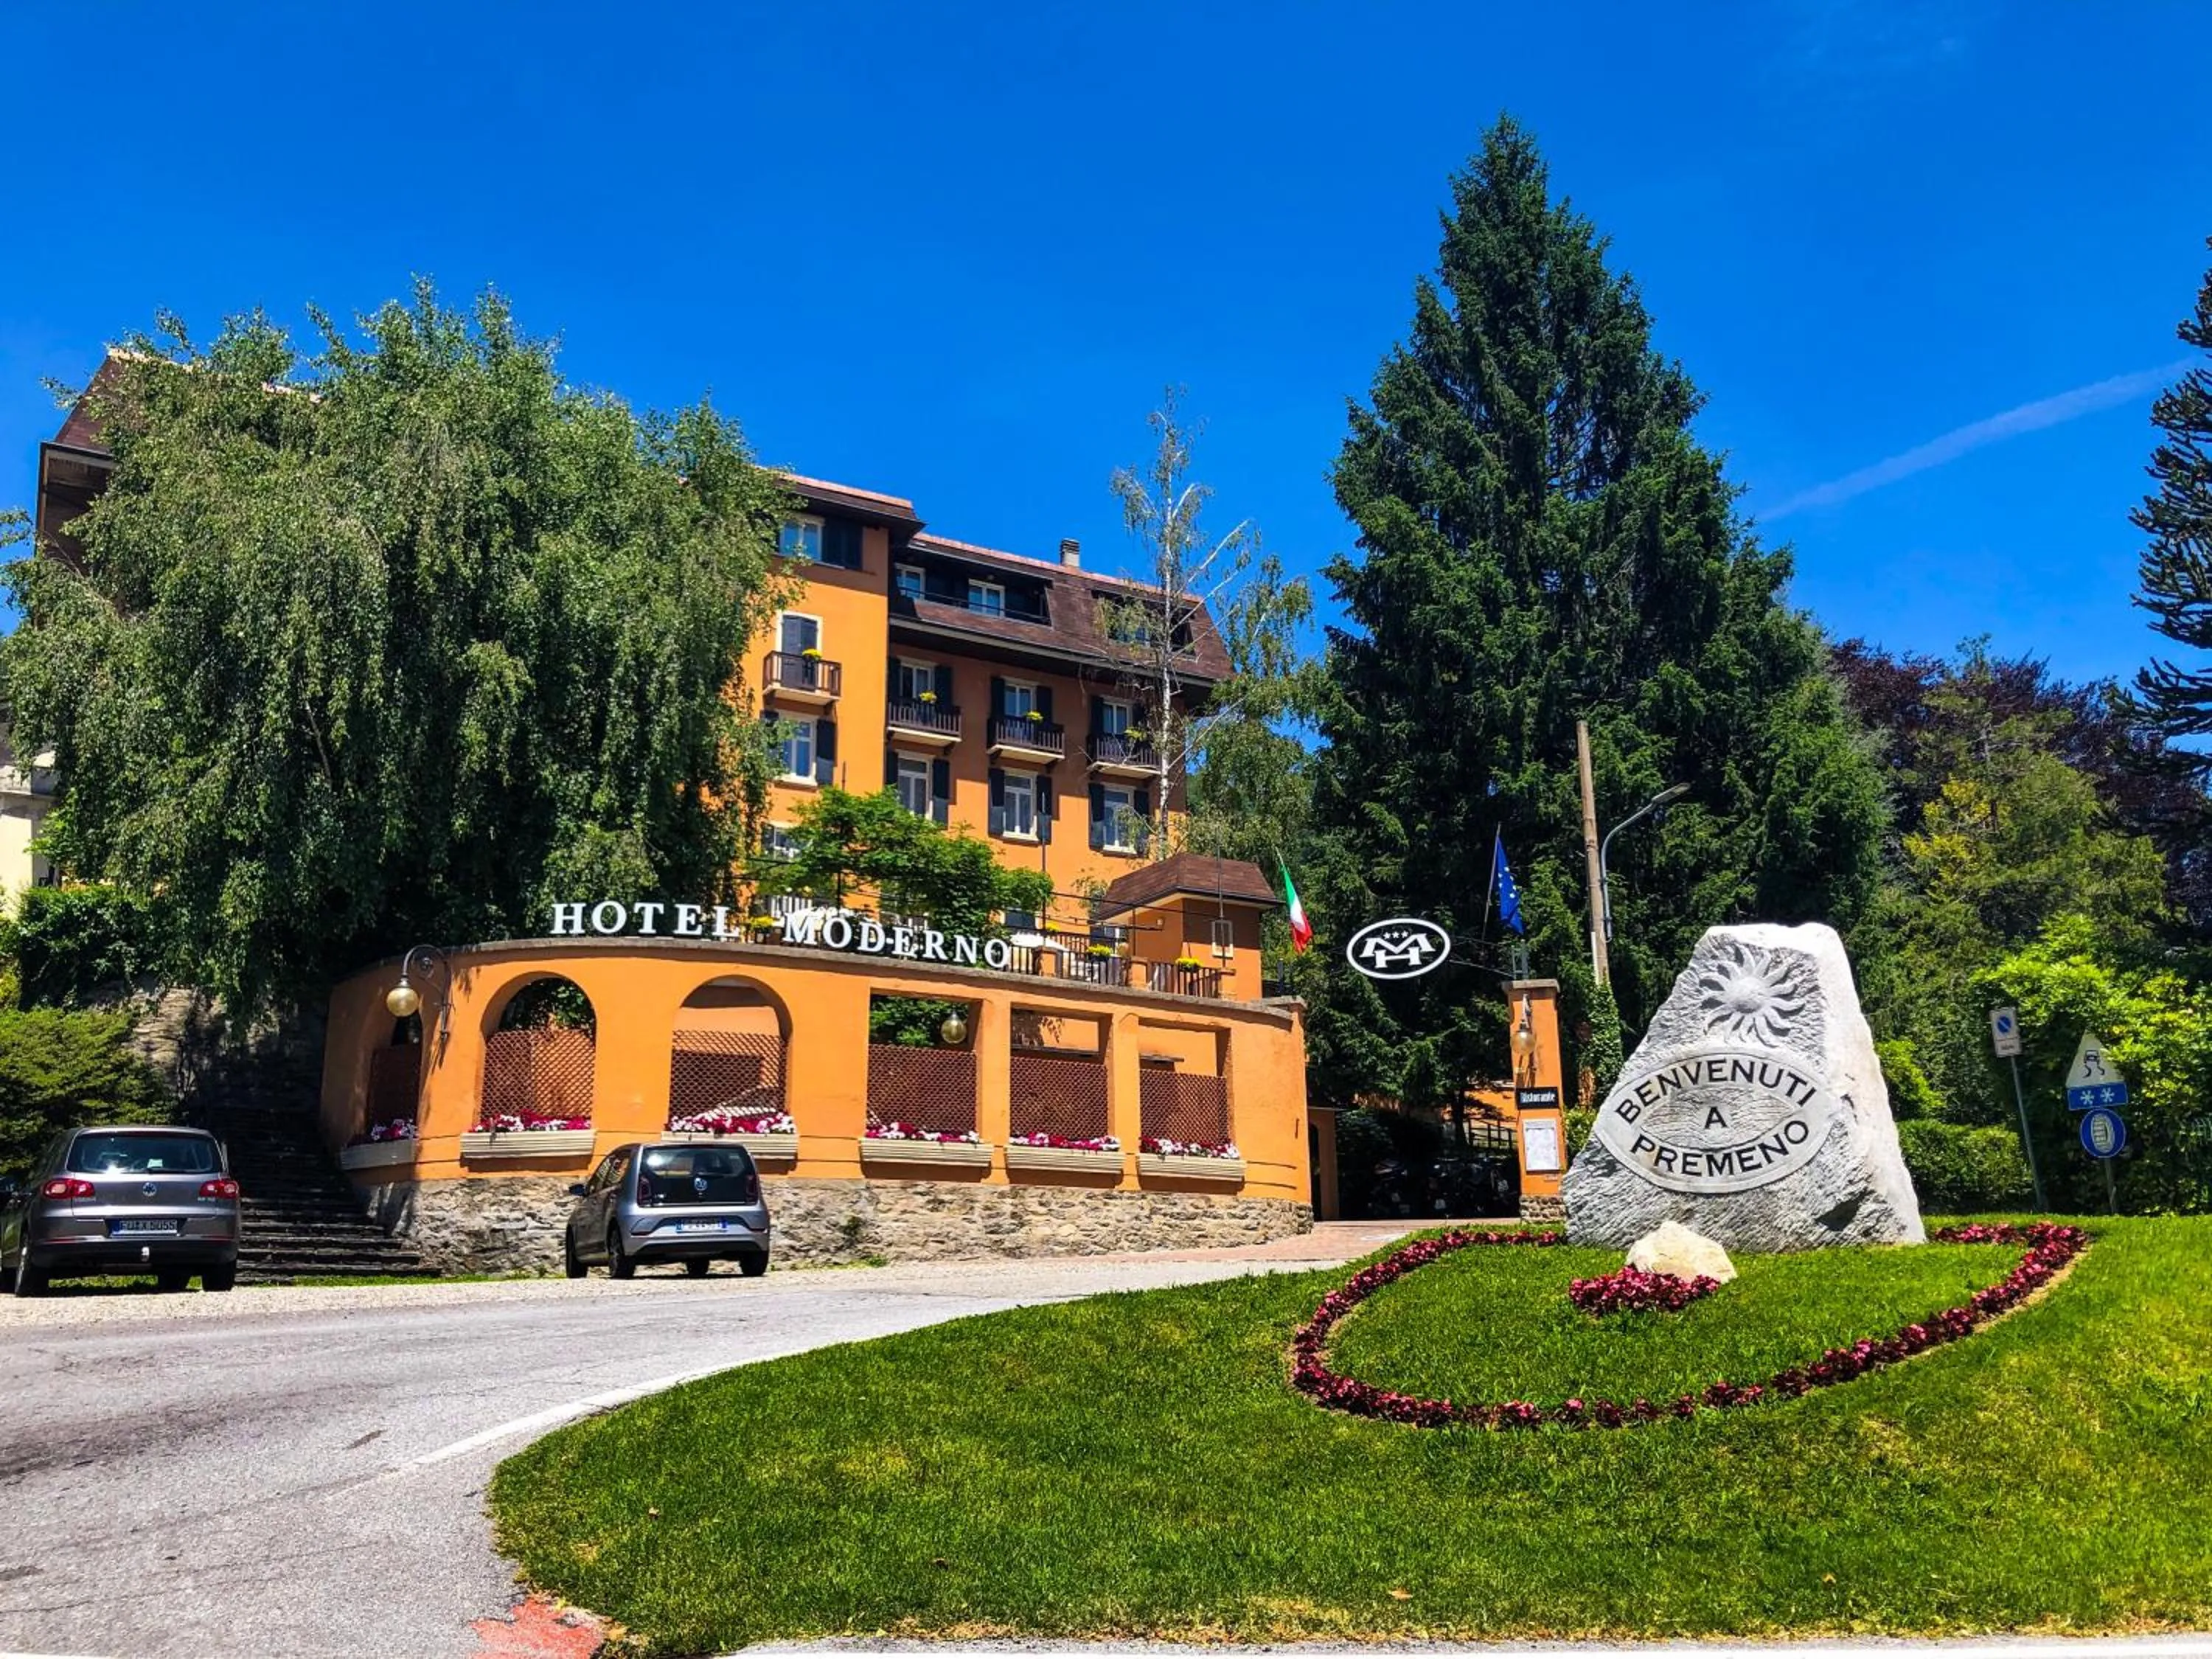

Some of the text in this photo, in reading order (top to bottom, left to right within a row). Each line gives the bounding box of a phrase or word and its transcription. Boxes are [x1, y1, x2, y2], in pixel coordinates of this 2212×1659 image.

[549, 900, 1011, 968] HOTEL MODERNO
[1615, 1058, 1818, 1124] BENVENUTI
[1704, 1106, 1728, 1130] A
[1630, 1119, 1810, 1178] PREMENO
